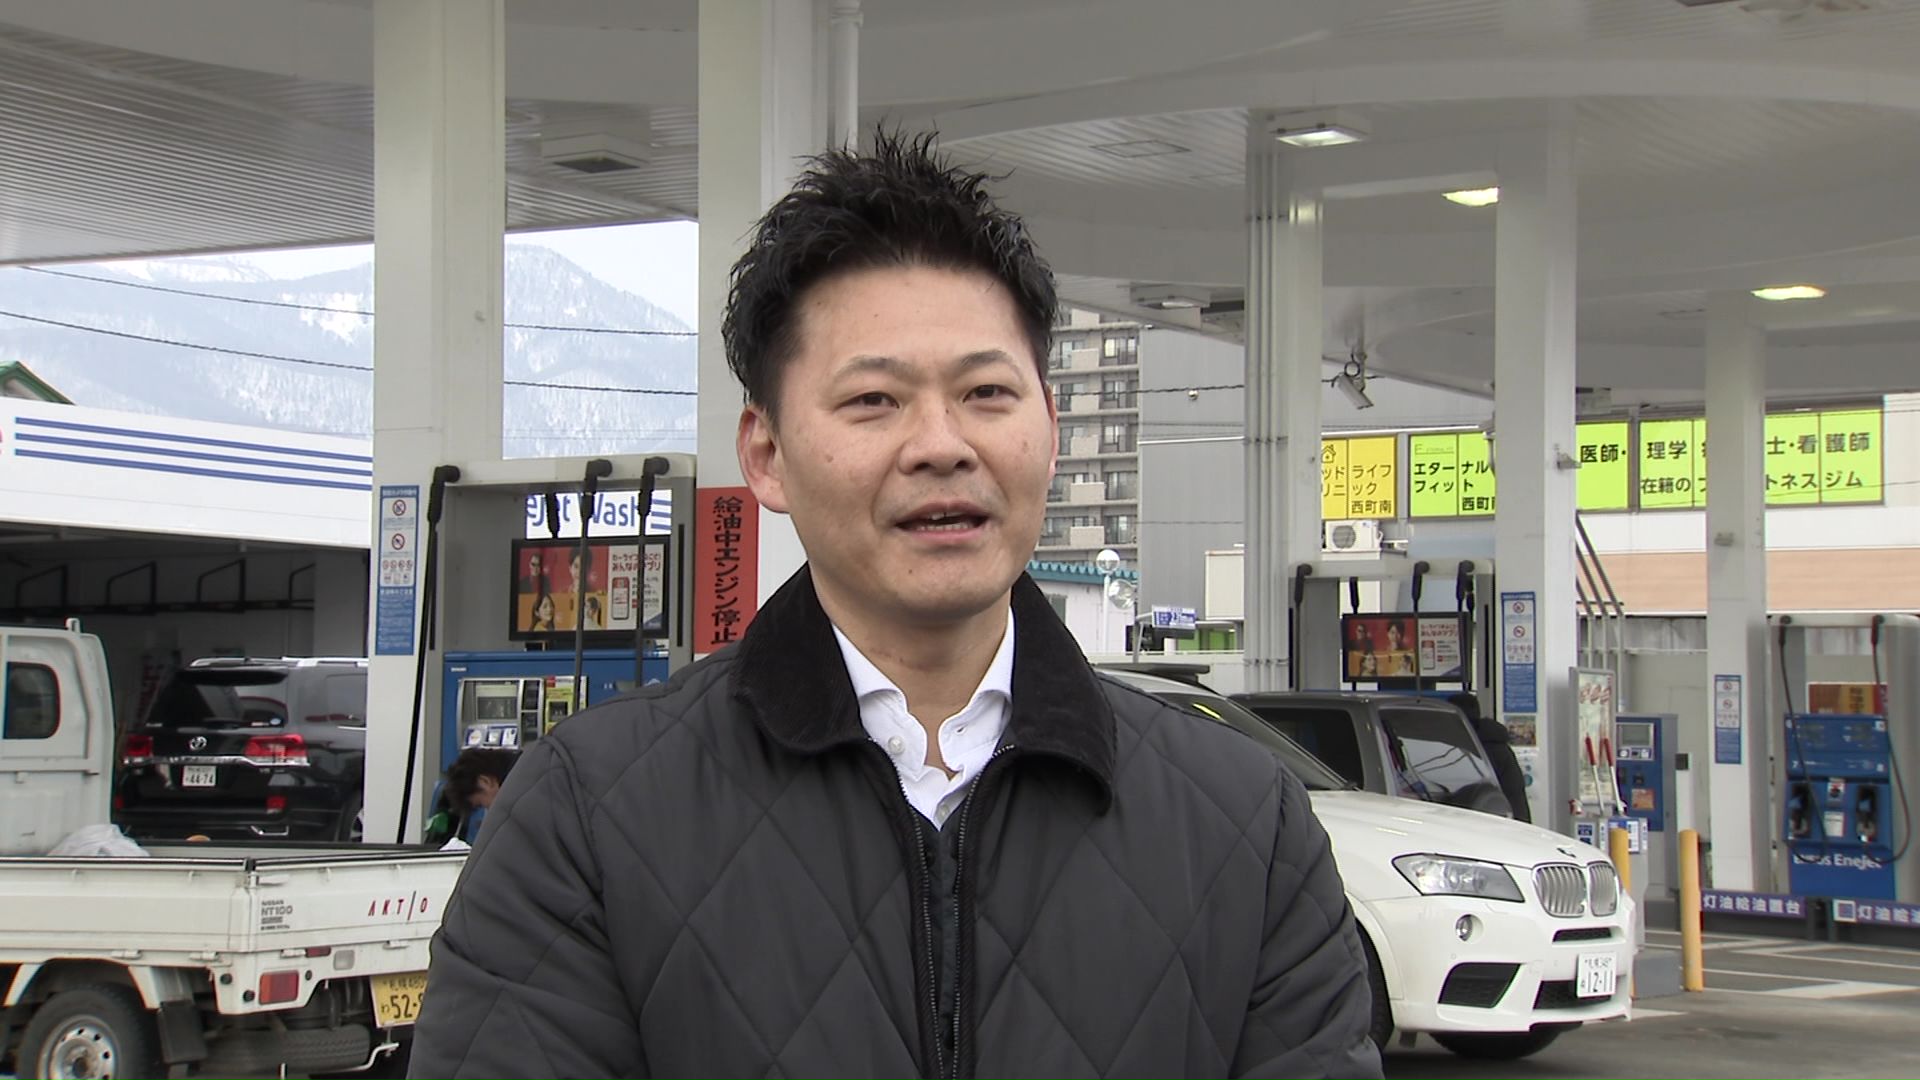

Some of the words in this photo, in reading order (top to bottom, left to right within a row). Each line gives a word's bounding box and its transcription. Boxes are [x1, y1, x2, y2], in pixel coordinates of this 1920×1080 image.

[1351, 500, 1392, 515] 西町南
[1462, 496, 1495, 512] 西町
[711, 496, 744, 645] 給油中エンジン停止
[261, 905, 293, 916] NT100
